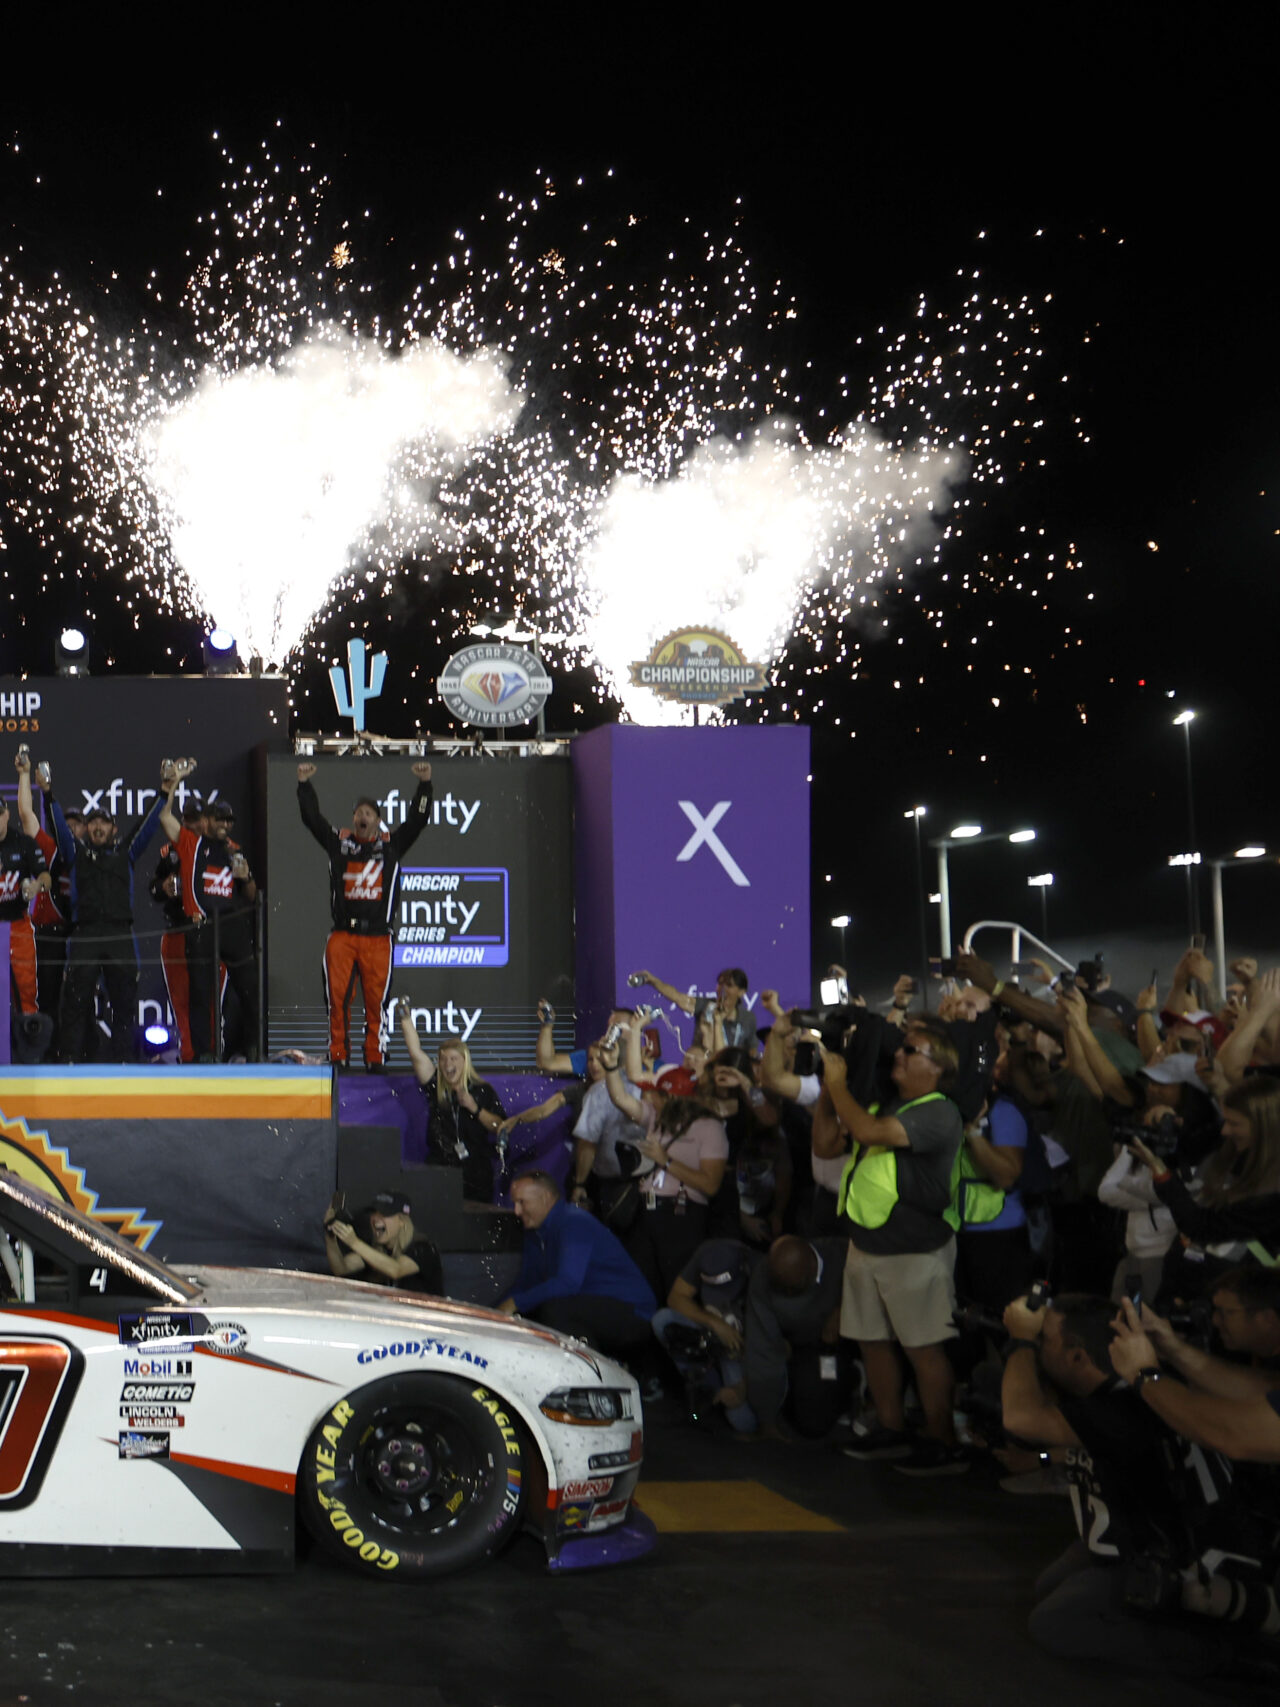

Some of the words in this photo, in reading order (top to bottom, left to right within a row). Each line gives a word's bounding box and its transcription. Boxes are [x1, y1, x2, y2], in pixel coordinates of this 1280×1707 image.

[452, 647, 501, 670] NASCAR
[686, 656, 720, 667] NASCAR
[641, 667, 756, 684] CHAMPIONSHIP
[450, 696, 539, 724] ANNIVERSARY
[401, 874, 460, 892] NASCAR
[397, 926, 447, 943] SERIES
[401, 946, 486, 965] CHAMPION
[89, 1267, 108, 1293] 4
[131, 1322, 181, 1342] xfinity
[356, 1337, 489, 1370] GOODYEAR
[123, 1359, 172, 1376] Mobil
[123, 1384, 193, 1401] COMETIC
[122, 1406, 174, 1418] LINCOLN
[471, 1386, 521, 1456] EAGLE
[133, 1417, 180, 1428] WELDERS
[316, 1399, 401, 1571] GOODYEAR
[502, 1488, 521, 1517] 75
